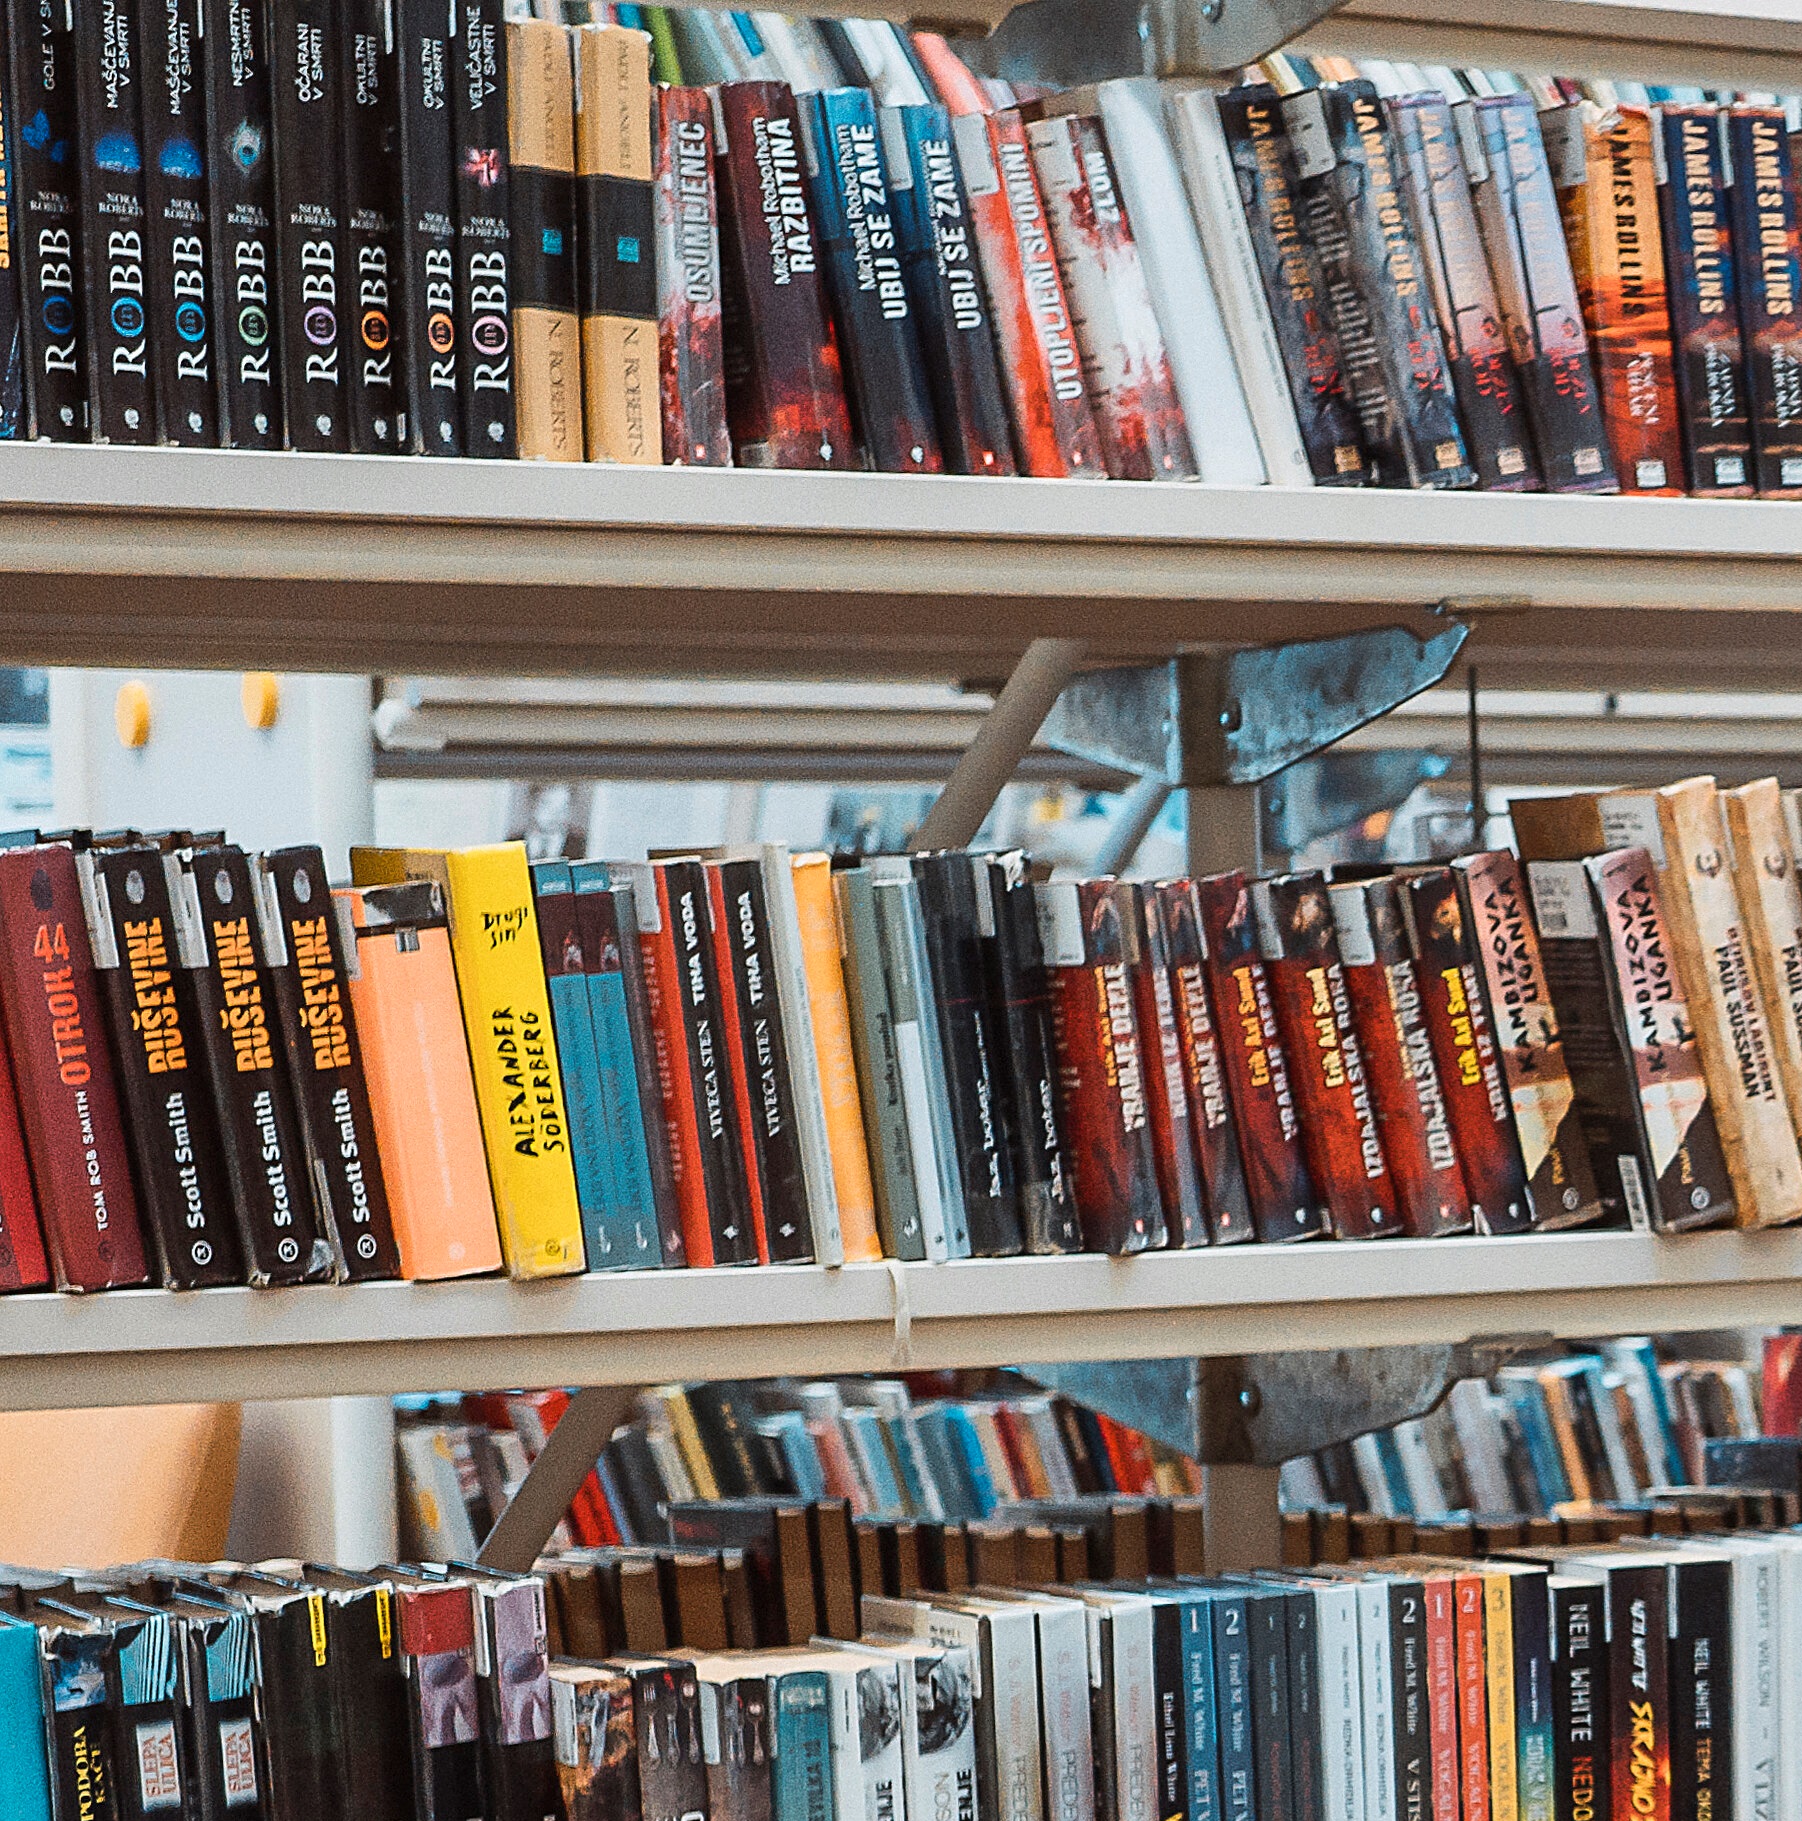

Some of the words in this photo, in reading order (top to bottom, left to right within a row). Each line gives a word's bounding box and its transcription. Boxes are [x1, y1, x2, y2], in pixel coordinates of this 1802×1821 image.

[41, 23, 52, 37] V
[116, 15, 130, 69] SMRTI
[179, 22, 192, 76] SMRTI
[241, 7, 254, 61] SMRTI
[294, 22, 312, 103] OČARANI
[310, 28, 323, 82] SMRTI
[366, 35, 379, 89] SMRTI
[464, 5, 484, 111] VELIČASTNE
[482, 23, 497, 77] SMRTI
[42, 44, 56, 91] GOLE
[118, 72, 131, 87] V
[181, 80, 193, 93] V
[245, 66, 255, 79] V
[312, 87, 324, 101] V
[355, 33, 368, 105] OKULTNI
[421, 37, 434, 109] OKULTNI
[432, 39, 445, 93] SMRTI
[485, 82, 497, 96] V
[434, 96, 445, 111] V
[751, 116, 780, 214] Robotham
[767, 117, 816, 273] RAZBITINA
[833, 124, 864, 218] Robotham
[850, 123, 887, 206] ZAME
[925, 139, 962, 218] ZAME
[1083, 151, 1121, 223] ZLOM
[1608, 128, 1637, 207] JAMES
[1681, 118, 1719, 207] JAMES
[1751, 121, 1784, 207] JAMES
[677, 121, 714, 303] OSUMLJENEC
[870, 213, 894, 250] SE
[997, 142, 1049, 254] SPOMINI
[1352, 98, 1394, 187] JAMES
[1376, 191, 1420, 299] ROLLINS
[763, 215, 792, 285] Michael
[850, 220, 878, 291] Michael
[943, 226, 969, 262] SE
[1614, 213, 1645, 318] ROLLINS
[1688, 211, 1726, 314] ROLLINS
[1758, 212, 1794, 316] ROLLINS
[877, 258, 908, 320] UBIJ
[953, 269, 983, 330] UBIJ
[1025, 261, 1083, 400] UTOPLJENI
[33, 921, 71, 964] 44
[1498, 875, 1540, 1003] UGANKA
[1630, 874, 1675, 1002] UGANKA
[123, 916, 188, 1075] RUŠEVINE
[212, 916, 275, 1073] RUŠEVINE
[291, 915, 352, 1072] RUŠEVINE
[1327, 962, 1352, 1029] ROKA
[1390, 958, 1419, 1027] ROKA
[1483, 889, 1538, 1074] KAMBIZOVA
[1613, 888, 1667, 1074] KAMBIZOVA
[43, 965, 91, 1087] OTROK
[696, 1019, 714, 1069] STEN
[753, 1018, 772, 1067] STEN
[1714, 945, 1738, 998] PAUL
[1726, 1000, 1761, 1099] SUSSMAN
[490, 1005, 539, 1159] ALEXANDER
[518, 1010, 565, 1154] SÖDERBERG
[702, 1070, 725, 1140] VIVECA
[760, 1069, 783, 1138] VIVECA
[1340, 1033, 1385, 1179] IZDAJALSKA
[1406, 1027, 1456, 1171] IZDAJALSKA
[74, 1090, 95, 1146] SMITH
[165, 1091, 194, 1163] Smith
[253, 1089, 280, 1162] Smith
[331, 1086, 358, 1159] Smith
[86, 1149, 102, 1186] ROB
[179, 1164, 207, 1229] Scott
[266, 1161, 293, 1227] Scott
[344, 1160, 372, 1224] Scott
[93, 1189, 110, 1232] TOM
[1189, 1608, 1199, 1634] 1
[1225, 1608, 1243, 1636] 2
[1401, 1597, 1416, 1624] 2
[1435, 1593, 1444, 1619] 1
[1460, 1587, 1476, 1614] 2
[1568, 1602, 1591, 1659] NEIL
[1570, 1666, 1593, 1743] WHITE
[141, 1735, 162, 1798] SLEPA
[157, 1732, 178, 1796] ULICA
[225, 1732, 241, 1793] SLEPA
[1406, 1757, 1420, 1776] V
